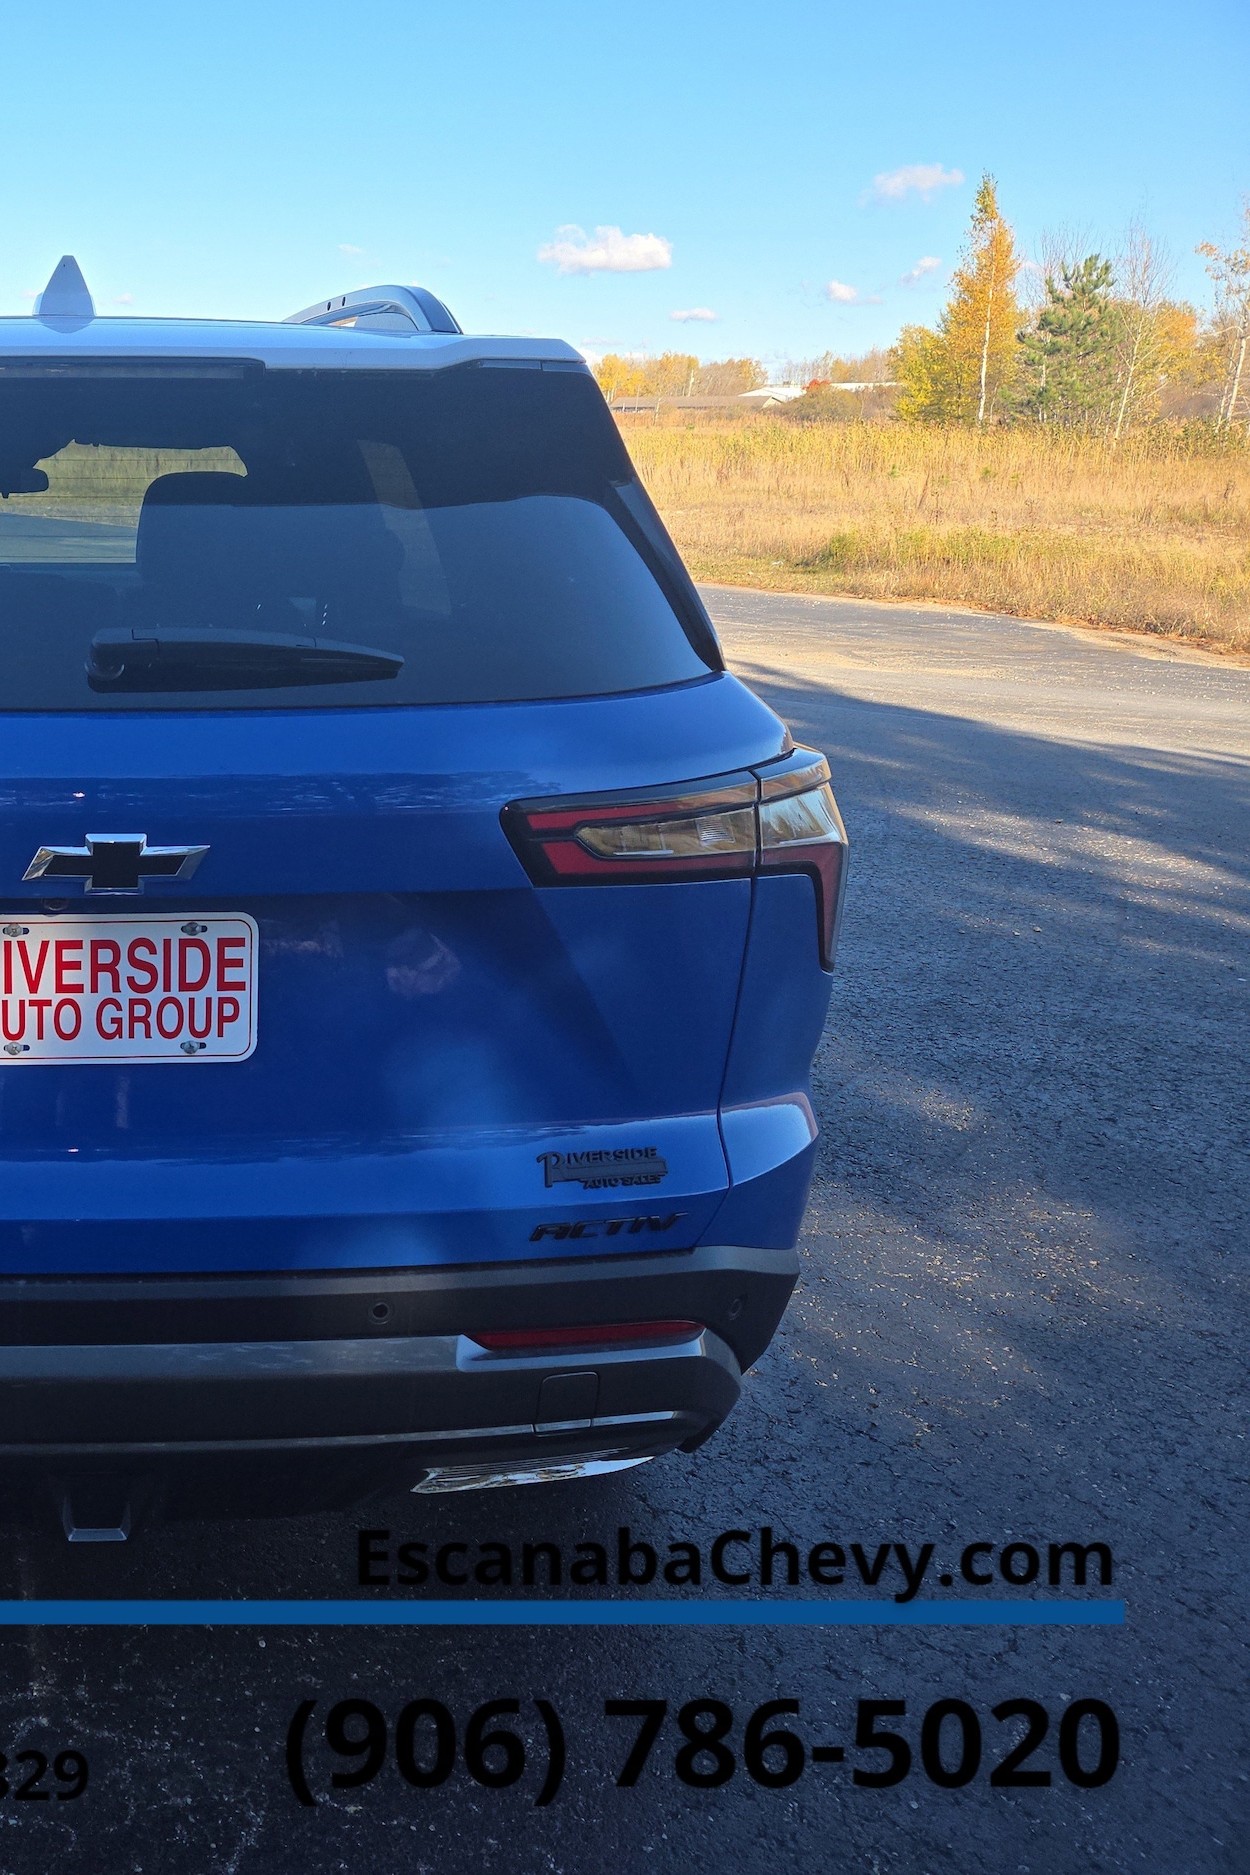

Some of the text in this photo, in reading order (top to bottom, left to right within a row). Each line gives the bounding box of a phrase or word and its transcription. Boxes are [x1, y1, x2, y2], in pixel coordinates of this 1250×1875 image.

[95, 997, 241, 1040] GROUP
[537, 1146, 658, 1188] RIVERSIDE
[529, 1212, 689, 1242] ACTIV
